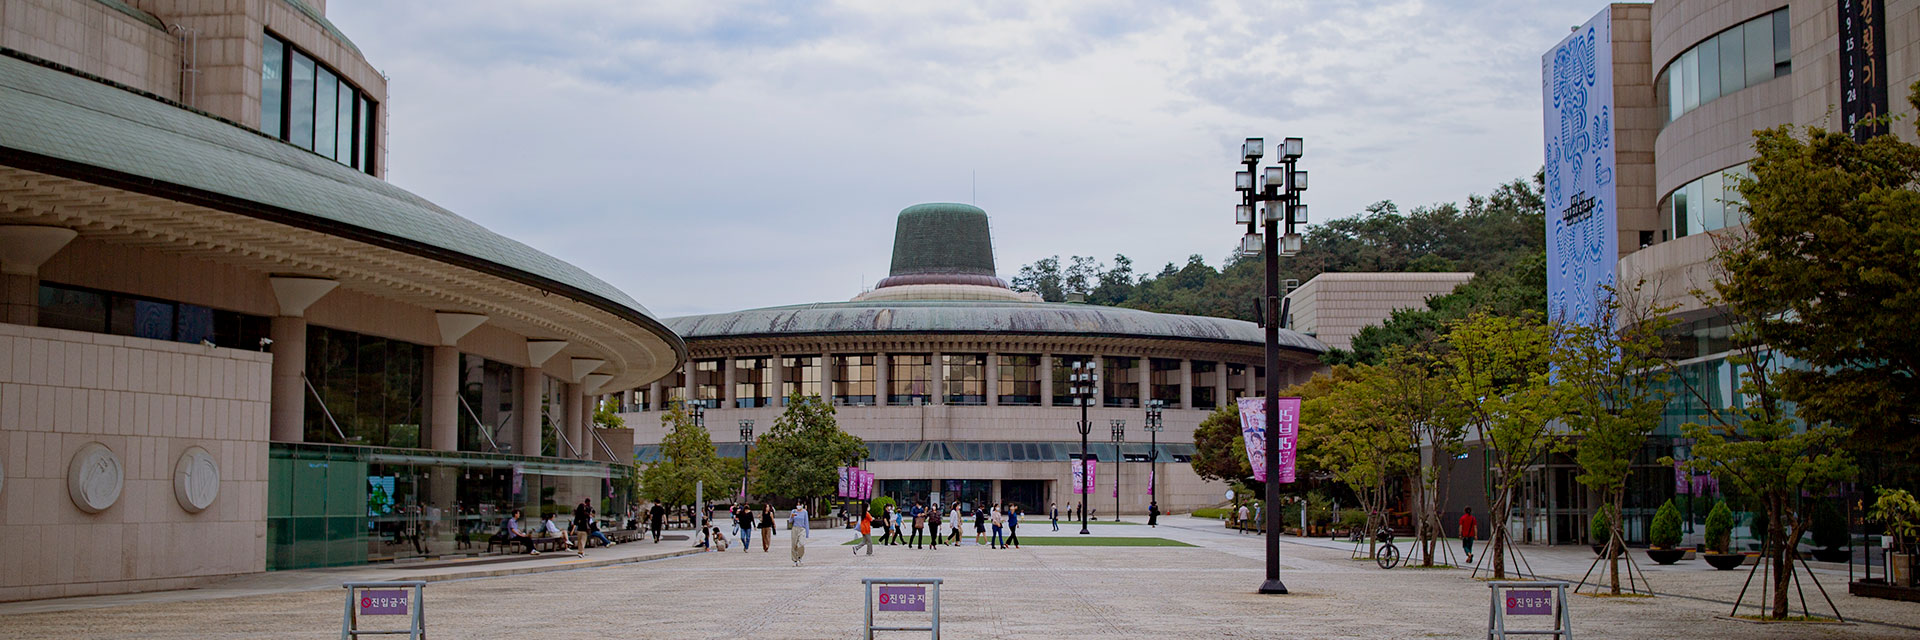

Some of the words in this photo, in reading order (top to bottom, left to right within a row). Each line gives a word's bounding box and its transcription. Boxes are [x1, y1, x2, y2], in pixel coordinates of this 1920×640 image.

[371, 597, 407, 608] 진입금지
[890, 593, 925, 604] 진입금지
[1516, 597, 1551, 608] 진입금지
